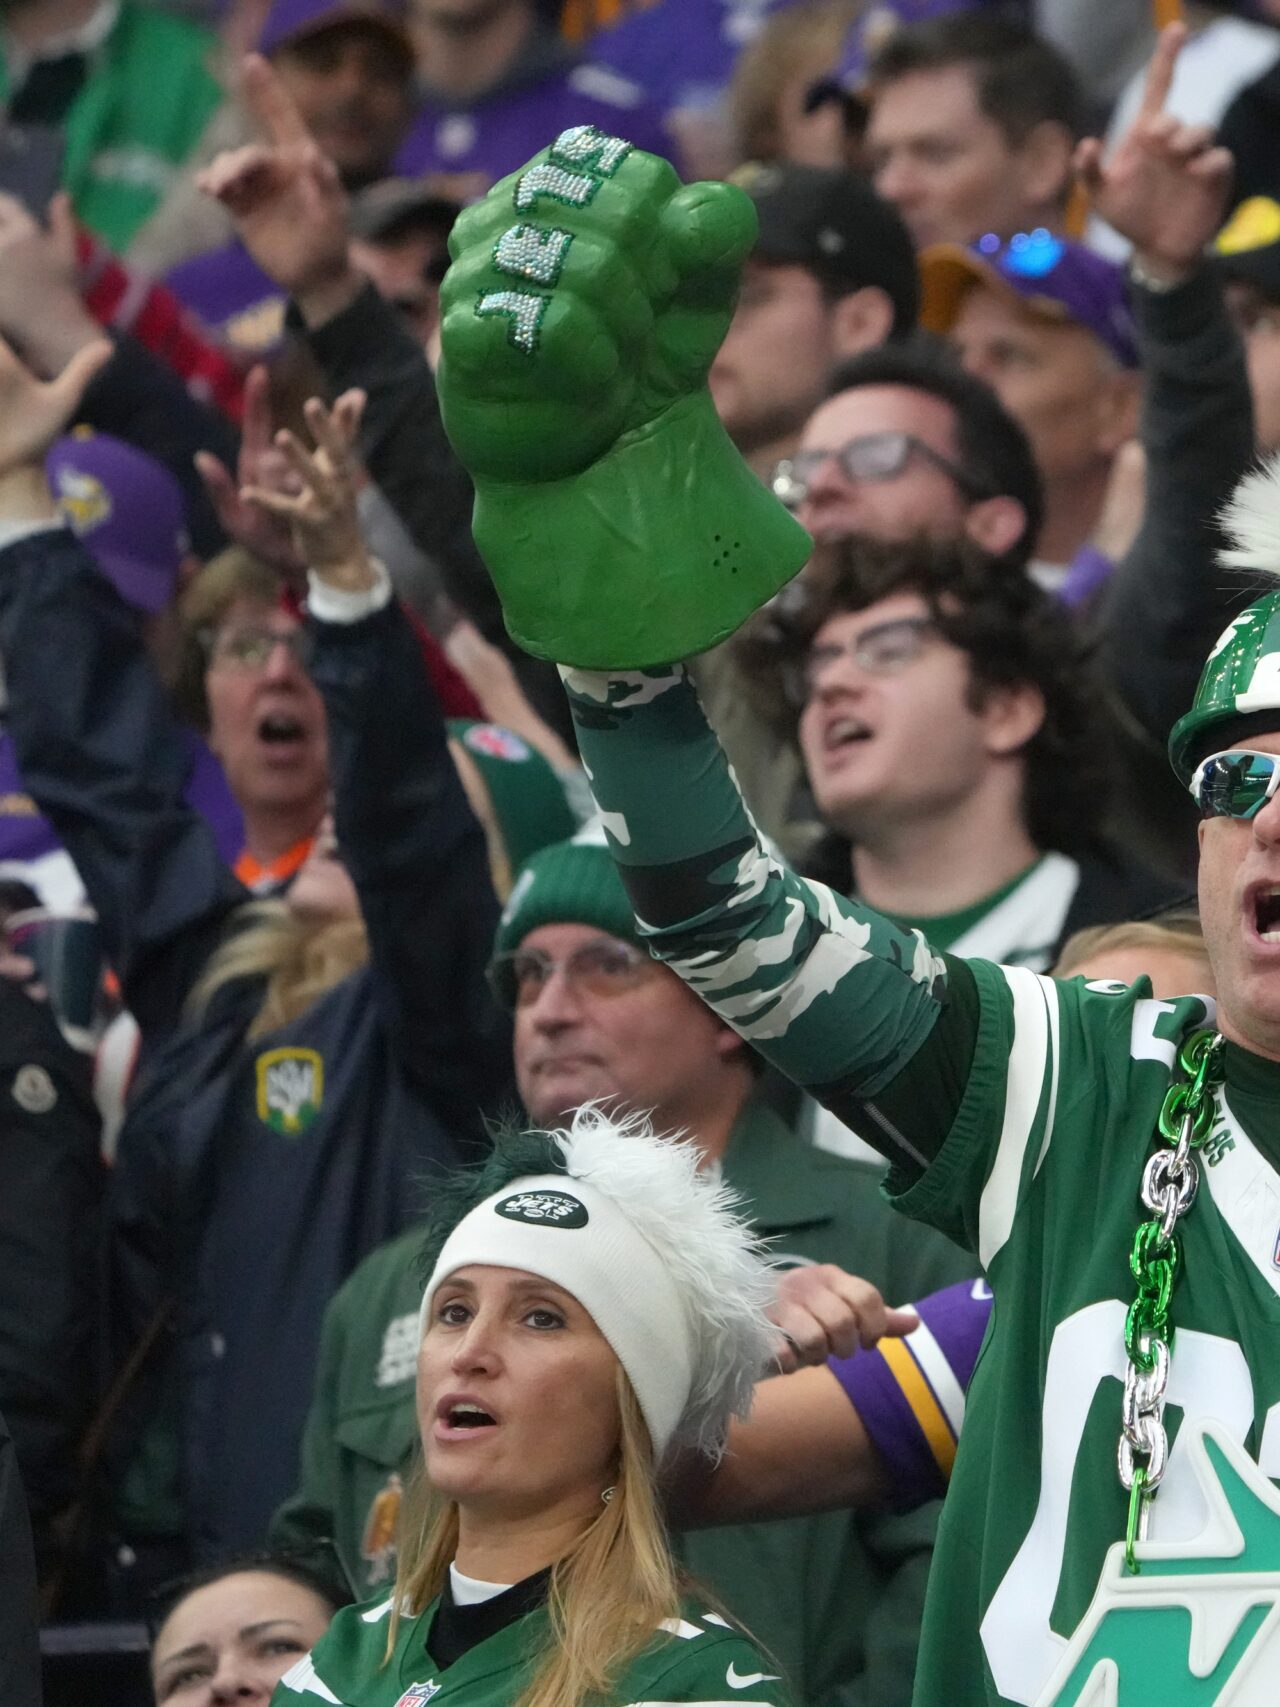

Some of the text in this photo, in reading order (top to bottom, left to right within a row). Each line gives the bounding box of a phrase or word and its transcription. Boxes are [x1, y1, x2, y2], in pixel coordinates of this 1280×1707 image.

[474, 125, 634, 354] JETS
[1203, 1128, 1236, 1169] 85
[505, 1199, 575, 1217] JETS
